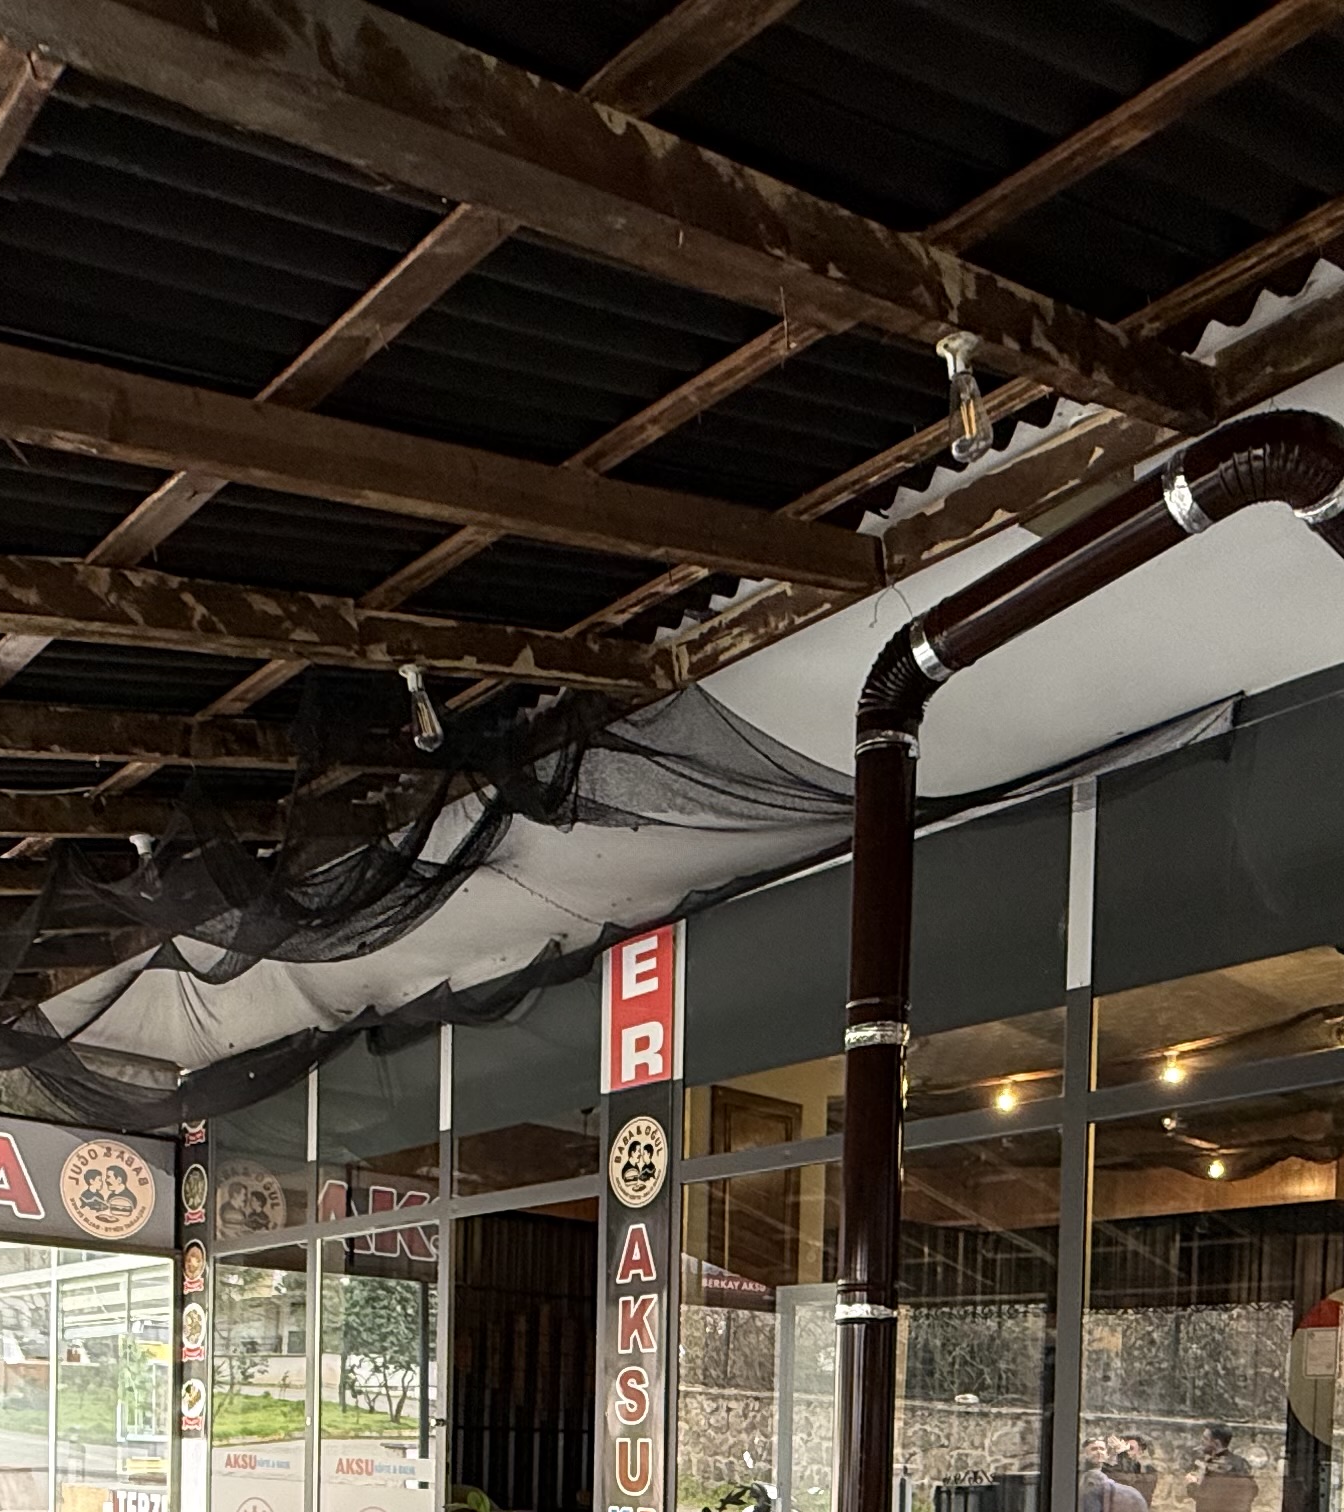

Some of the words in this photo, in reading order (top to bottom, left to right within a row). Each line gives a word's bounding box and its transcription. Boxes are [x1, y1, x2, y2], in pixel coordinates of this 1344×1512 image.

[621, 935, 665, 1083] ER
[614, 1130, 635, 1164] BABA
[644, 1125, 664, 1157] OĞUL
[703, 1278, 741, 1292] BERKAY
[615, 1222, 658, 1496] AKSU
[224, 1453, 257, 1470] AKSU
[335, 1457, 375, 1476] AKSU
